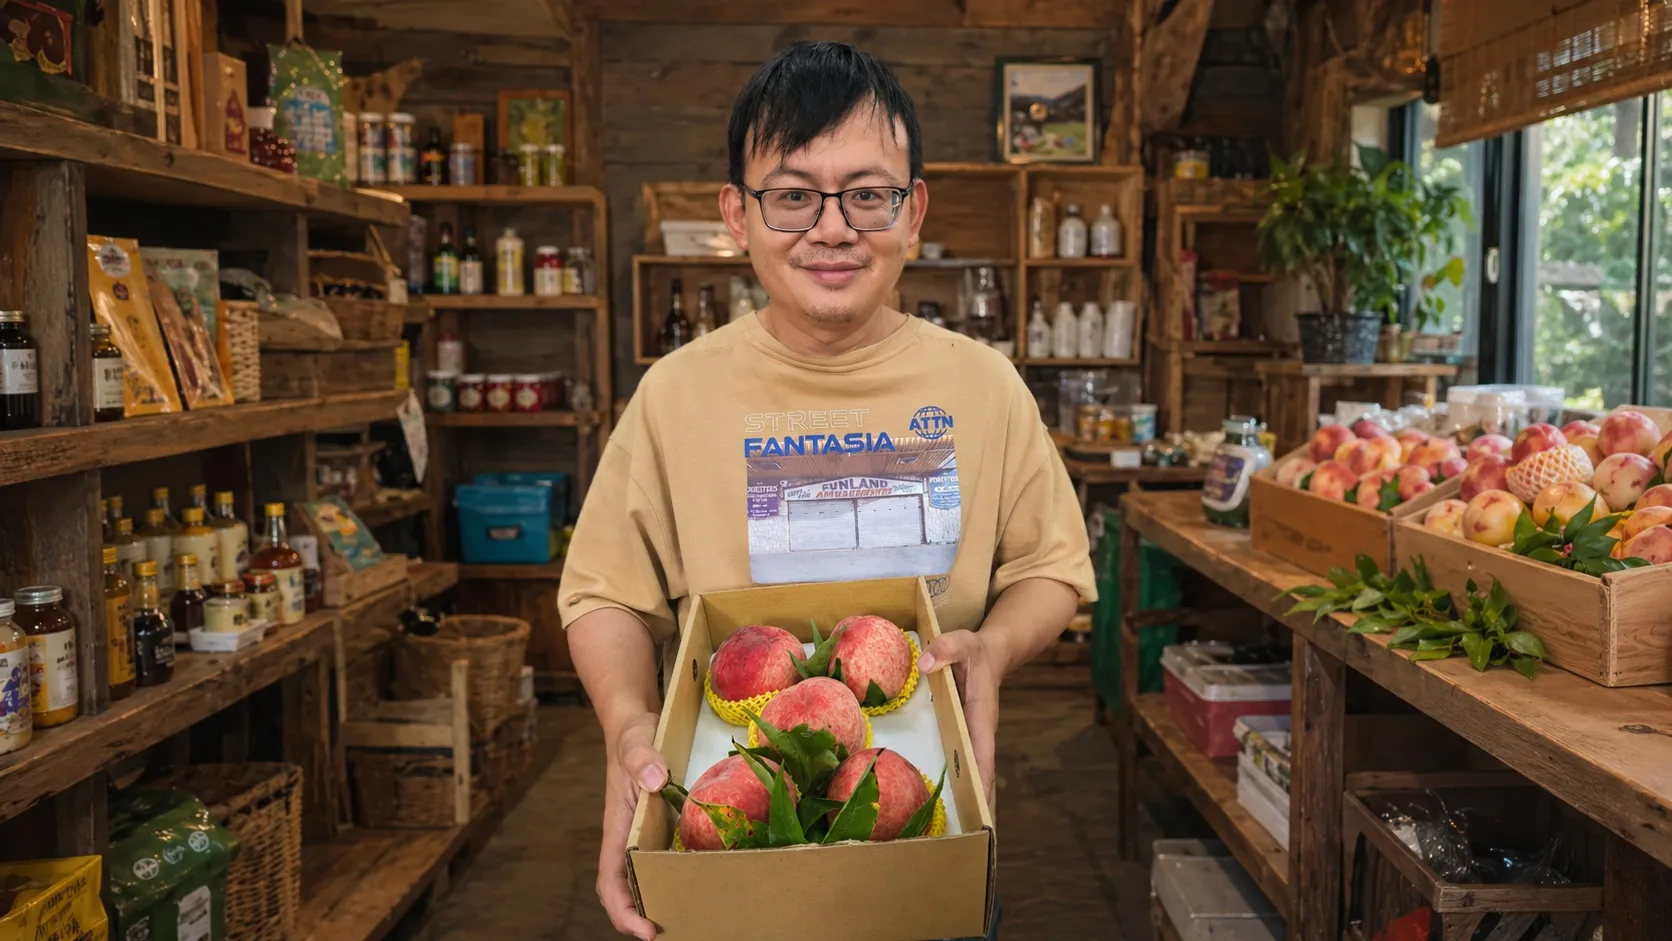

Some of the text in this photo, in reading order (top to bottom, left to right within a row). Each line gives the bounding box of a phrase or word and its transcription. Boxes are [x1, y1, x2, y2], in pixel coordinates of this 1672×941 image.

[744, 408, 869, 433] STREET
[909, 415, 954, 431] ATTN
[744, 432, 896, 458] FANTASIA
[822, 478, 888, 491] FUNLAND
